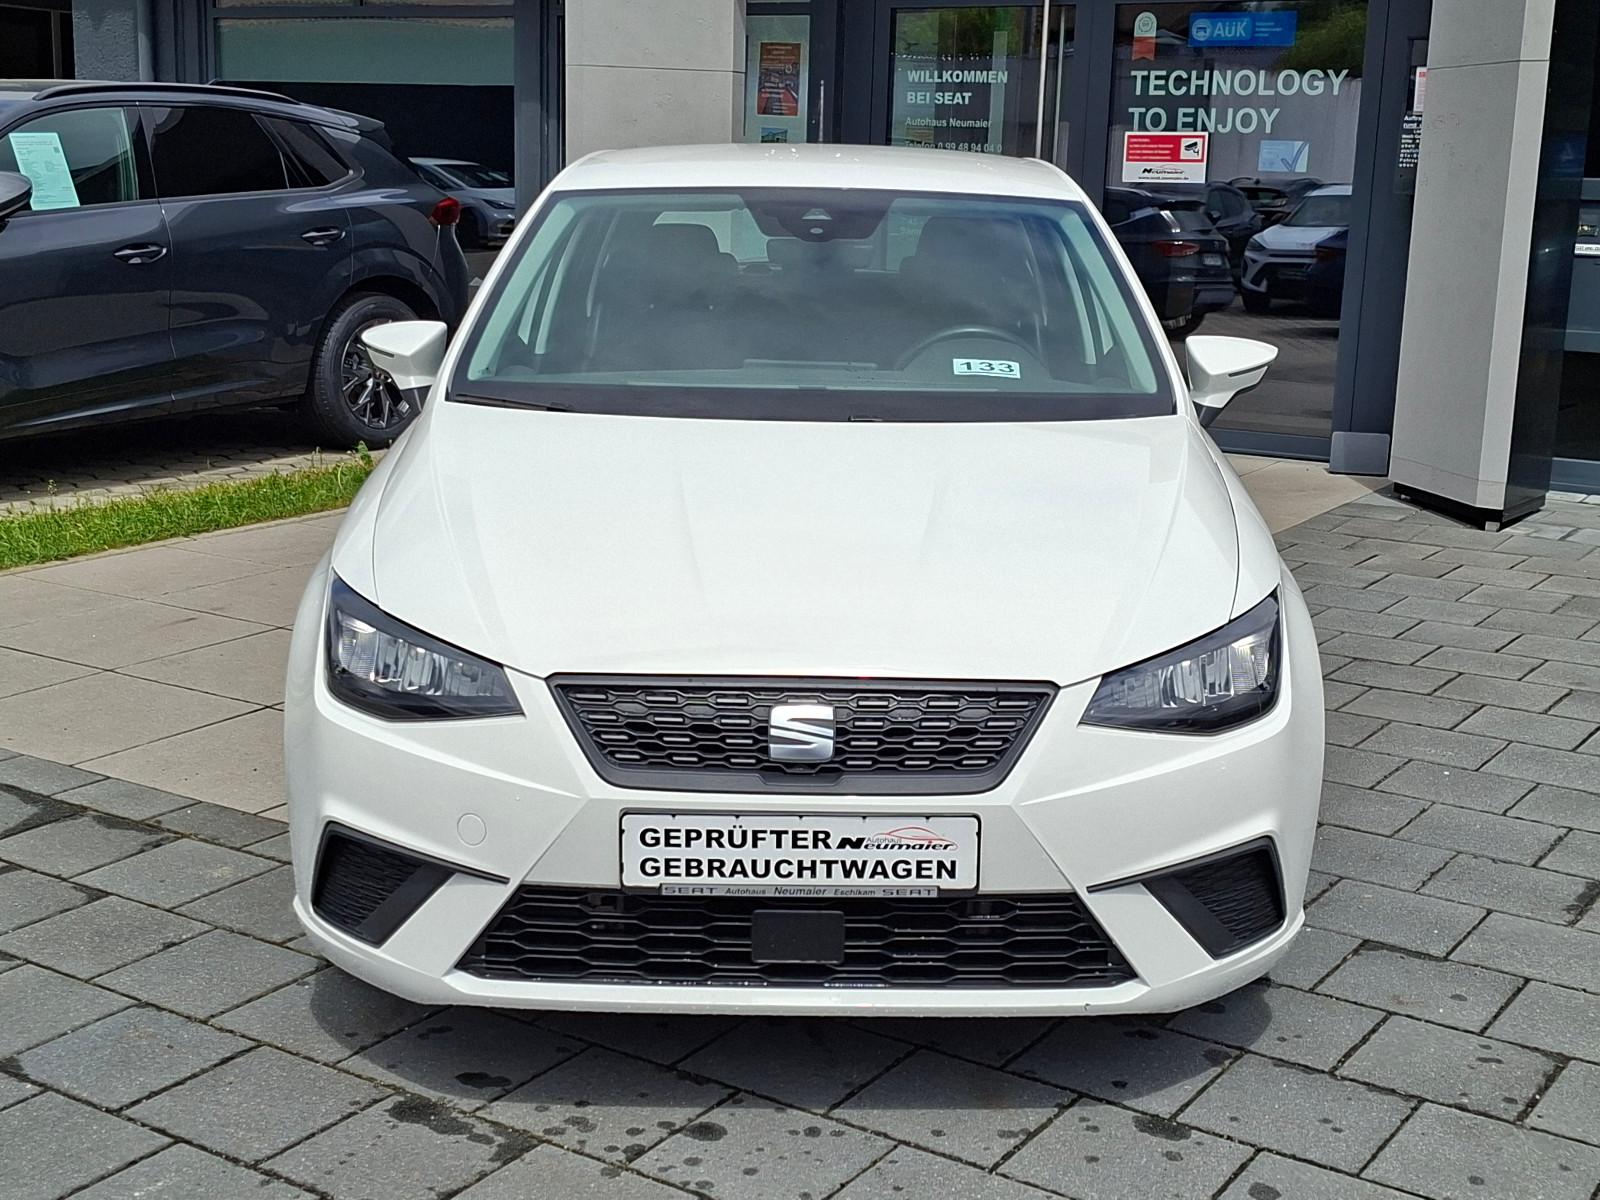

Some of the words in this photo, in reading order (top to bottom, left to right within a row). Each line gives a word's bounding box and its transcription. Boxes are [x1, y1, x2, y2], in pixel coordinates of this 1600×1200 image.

[907, 70, 1008, 83] WILLKOMMEN
[1130, 69, 1349, 96] TECHNOLOGY
[906, 92, 930, 104] BEI
[934, 92, 972, 104] SEAT
[905, 117, 947, 127] Autohaus
[949, 118, 992, 128] Neumaier
[1128, 107, 1167, 132] TO
[1176, 107, 1280, 134] ENJOY
[960, 361, 1015, 373] 133
[639, 825, 832, 850] GEPRÜFTER
[836, 837, 954, 851] Neumaier
[639, 857, 957, 880] GEBRAUCHTWAGEN
[664, 886, 718, 895] SEAT
[725, 887, 767, 896] Autohaus
[774, 886, 827, 897] Neumaier
[882, 888, 937, 897] SEAT
